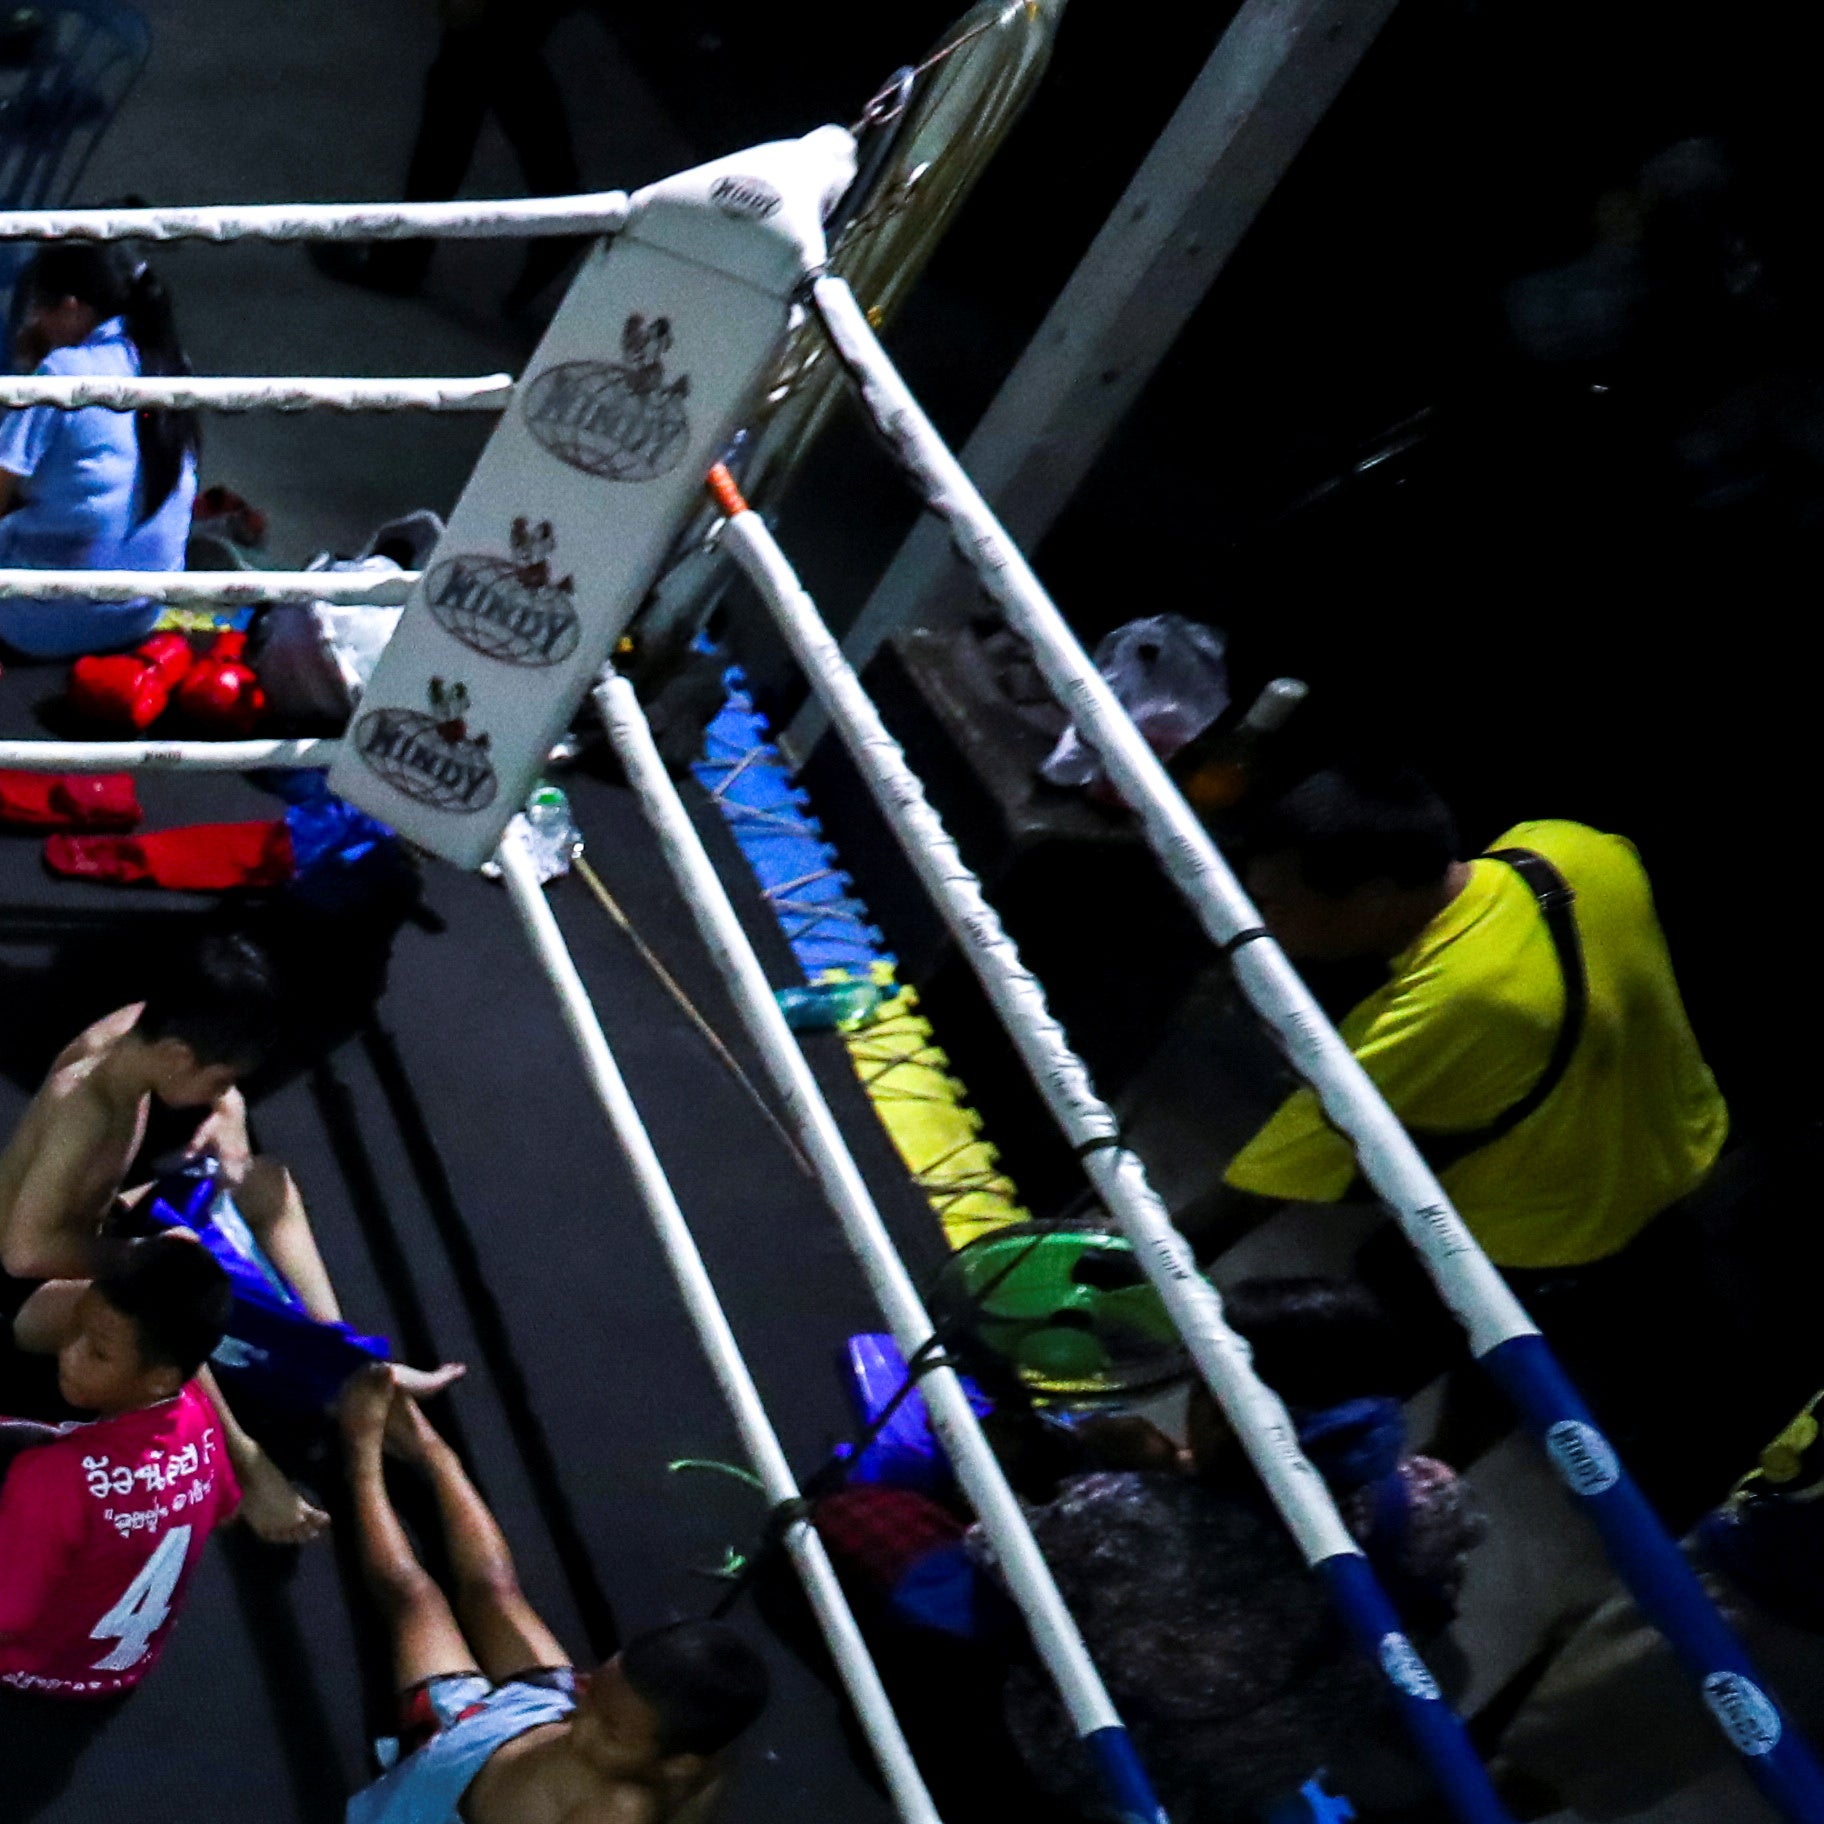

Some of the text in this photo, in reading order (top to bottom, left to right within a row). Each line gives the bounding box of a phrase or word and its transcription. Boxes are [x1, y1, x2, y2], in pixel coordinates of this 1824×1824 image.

[713, 178, 782, 218] WINDY
[530, 382, 687, 465] WINDY
[438, 572, 573, 653] WINDY
[366, 714, 490, 800] WINDY
[1550, 1426, 1611, 1488] WINDY
[88, 1523, 192, 1671] 4
